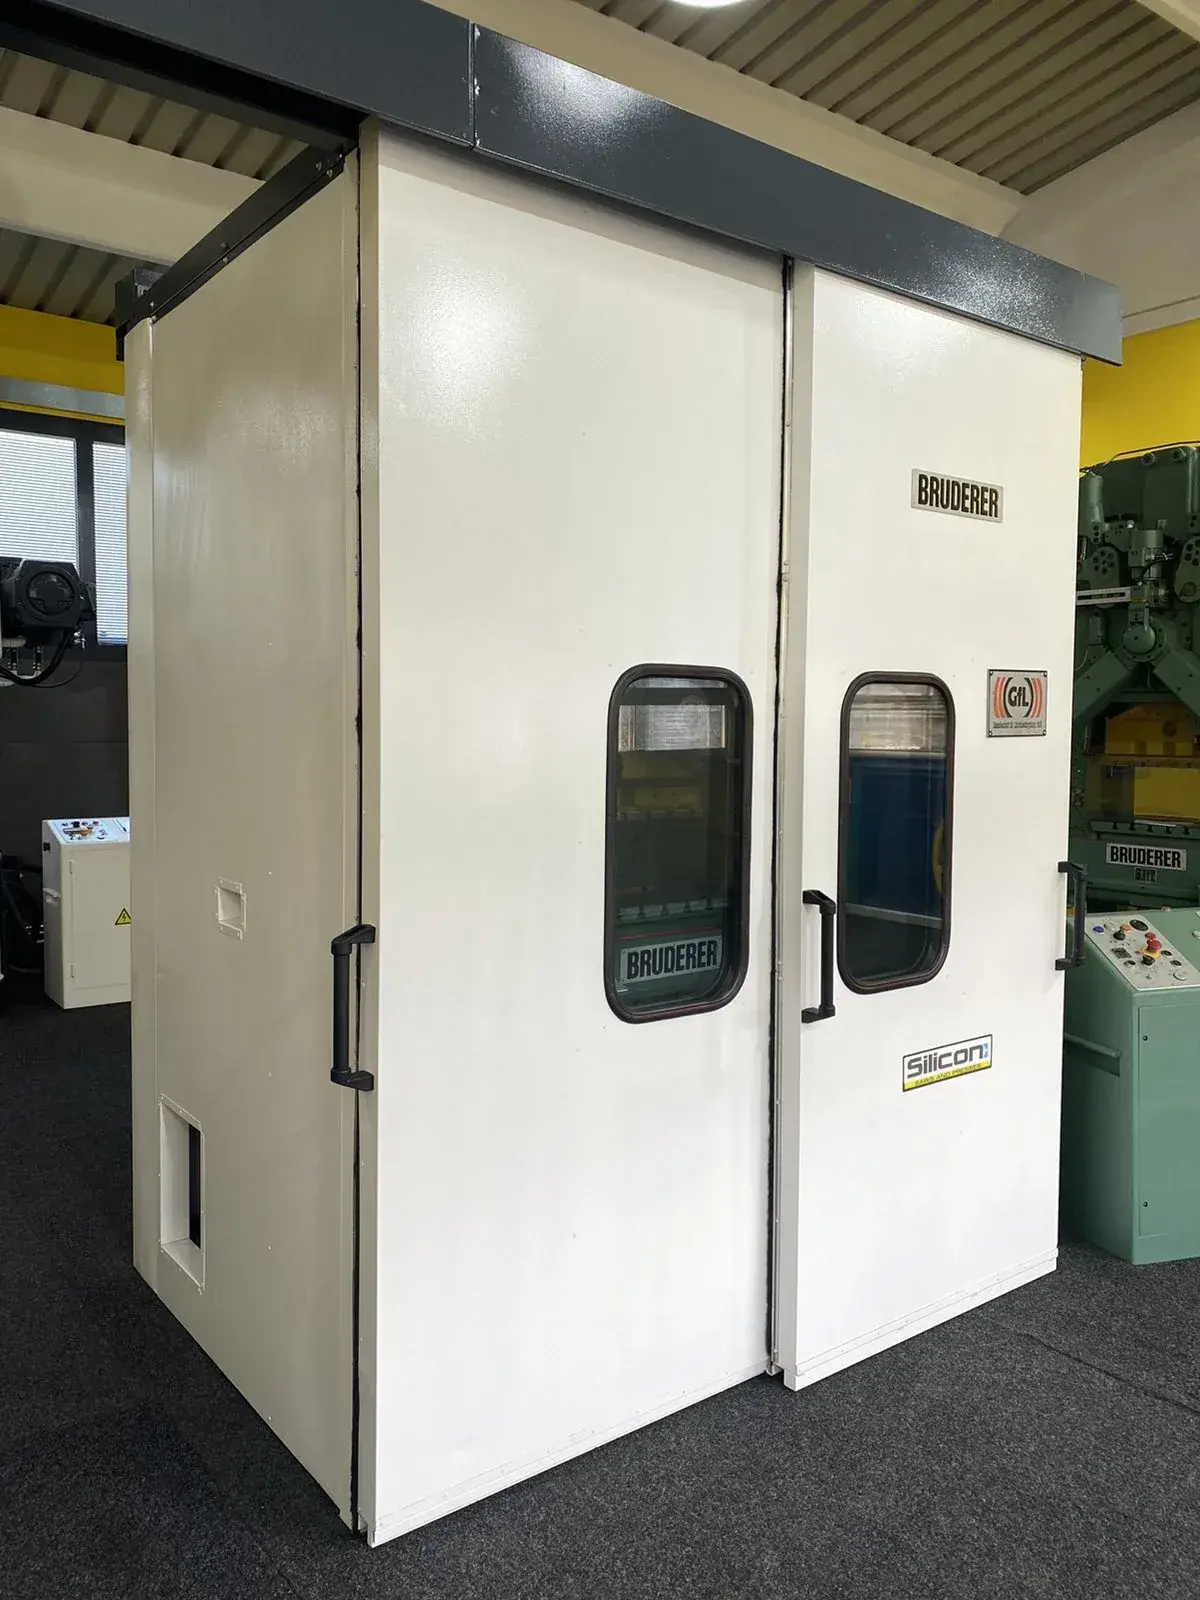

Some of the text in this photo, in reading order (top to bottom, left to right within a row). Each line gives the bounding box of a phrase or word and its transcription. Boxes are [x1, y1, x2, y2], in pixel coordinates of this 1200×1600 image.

[918, 474, 999, 518] BRUDERER
[1008, 686, 1029, 707] GfL
[1111, 846, 1181, 868] BRUDERER
[627, 940, 718, 979] BRUDERER
[907, 1044, 983, 1079] Silicon
[915, 1075, 935, 1085] SAWS
[937, 1071, 951, 1080] AND
